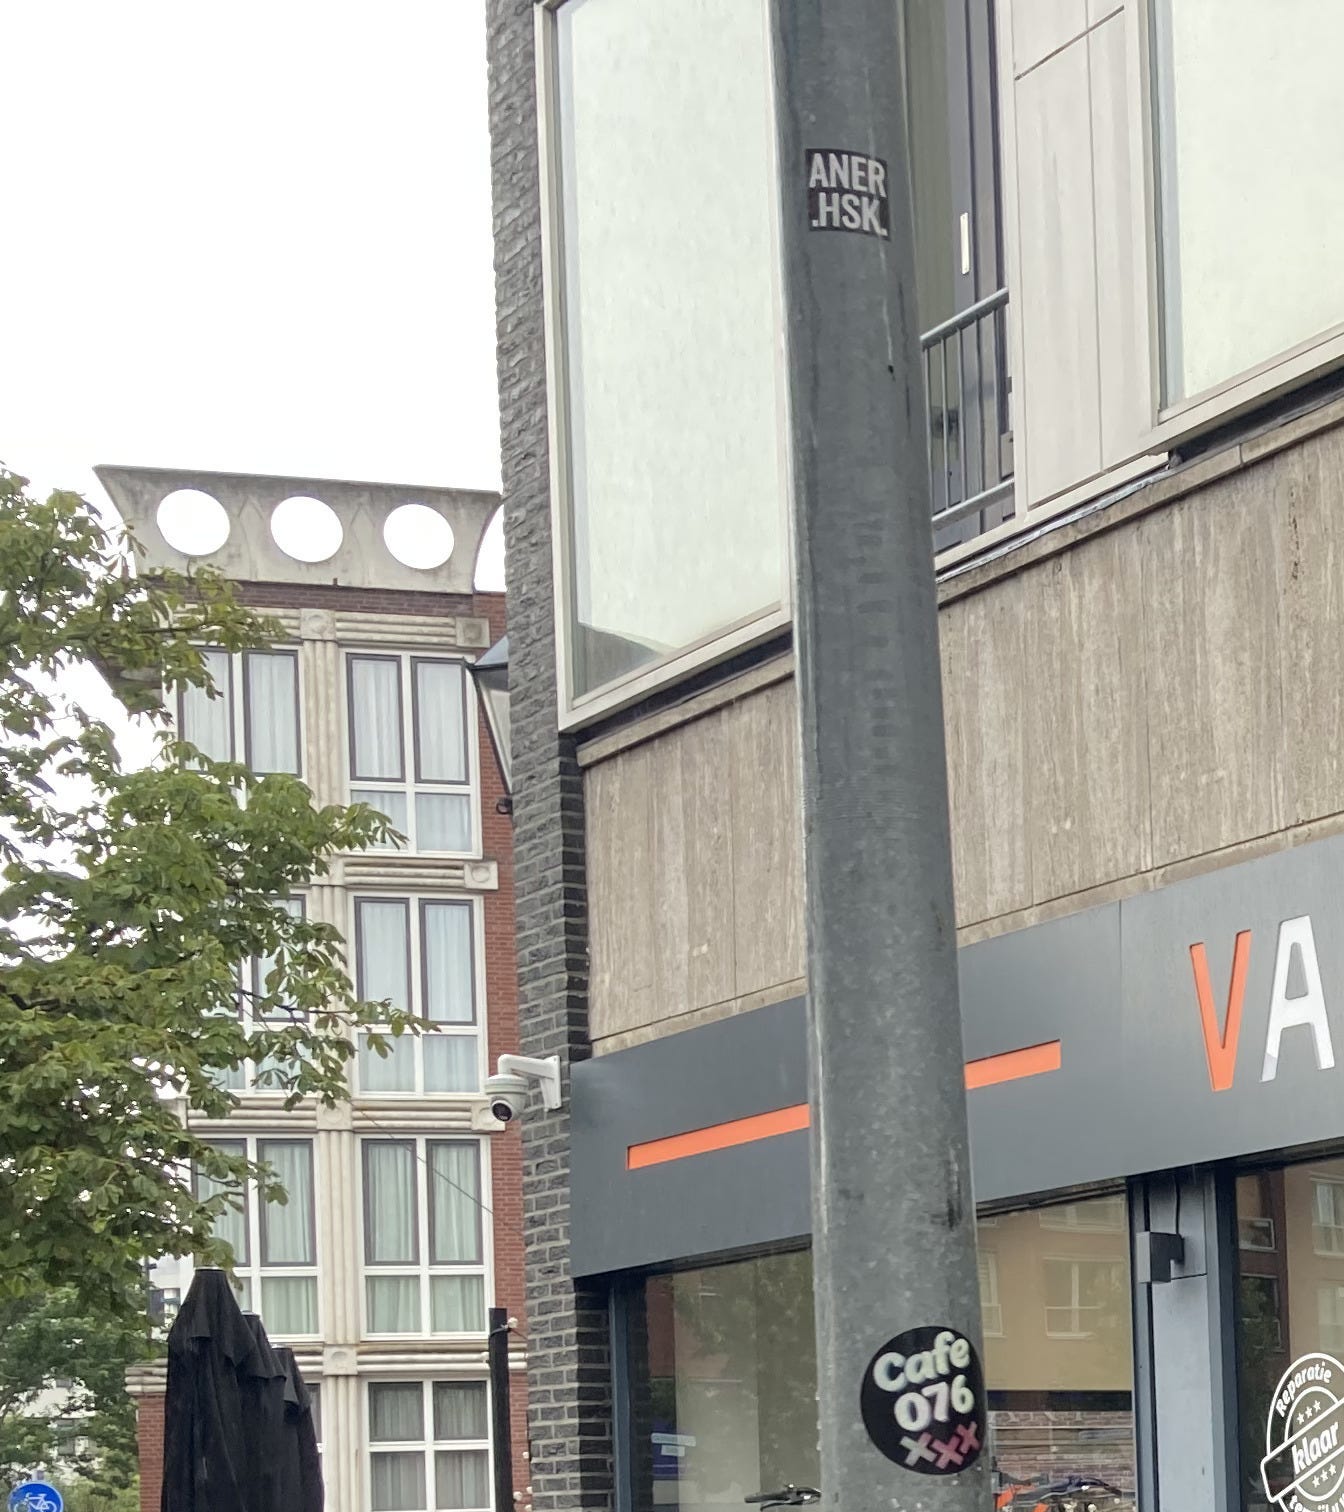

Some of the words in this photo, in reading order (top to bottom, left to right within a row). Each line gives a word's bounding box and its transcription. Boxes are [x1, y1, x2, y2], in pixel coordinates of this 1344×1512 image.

[809, 152, 887, 198] ANER
[873, 1331, 970, 1392] Cafe
[1275, 1361, 1333, 1418] Reparatie
[893, 1374, 976, 1432] 076
[1291, 1421, 1339, 1475] klaar
